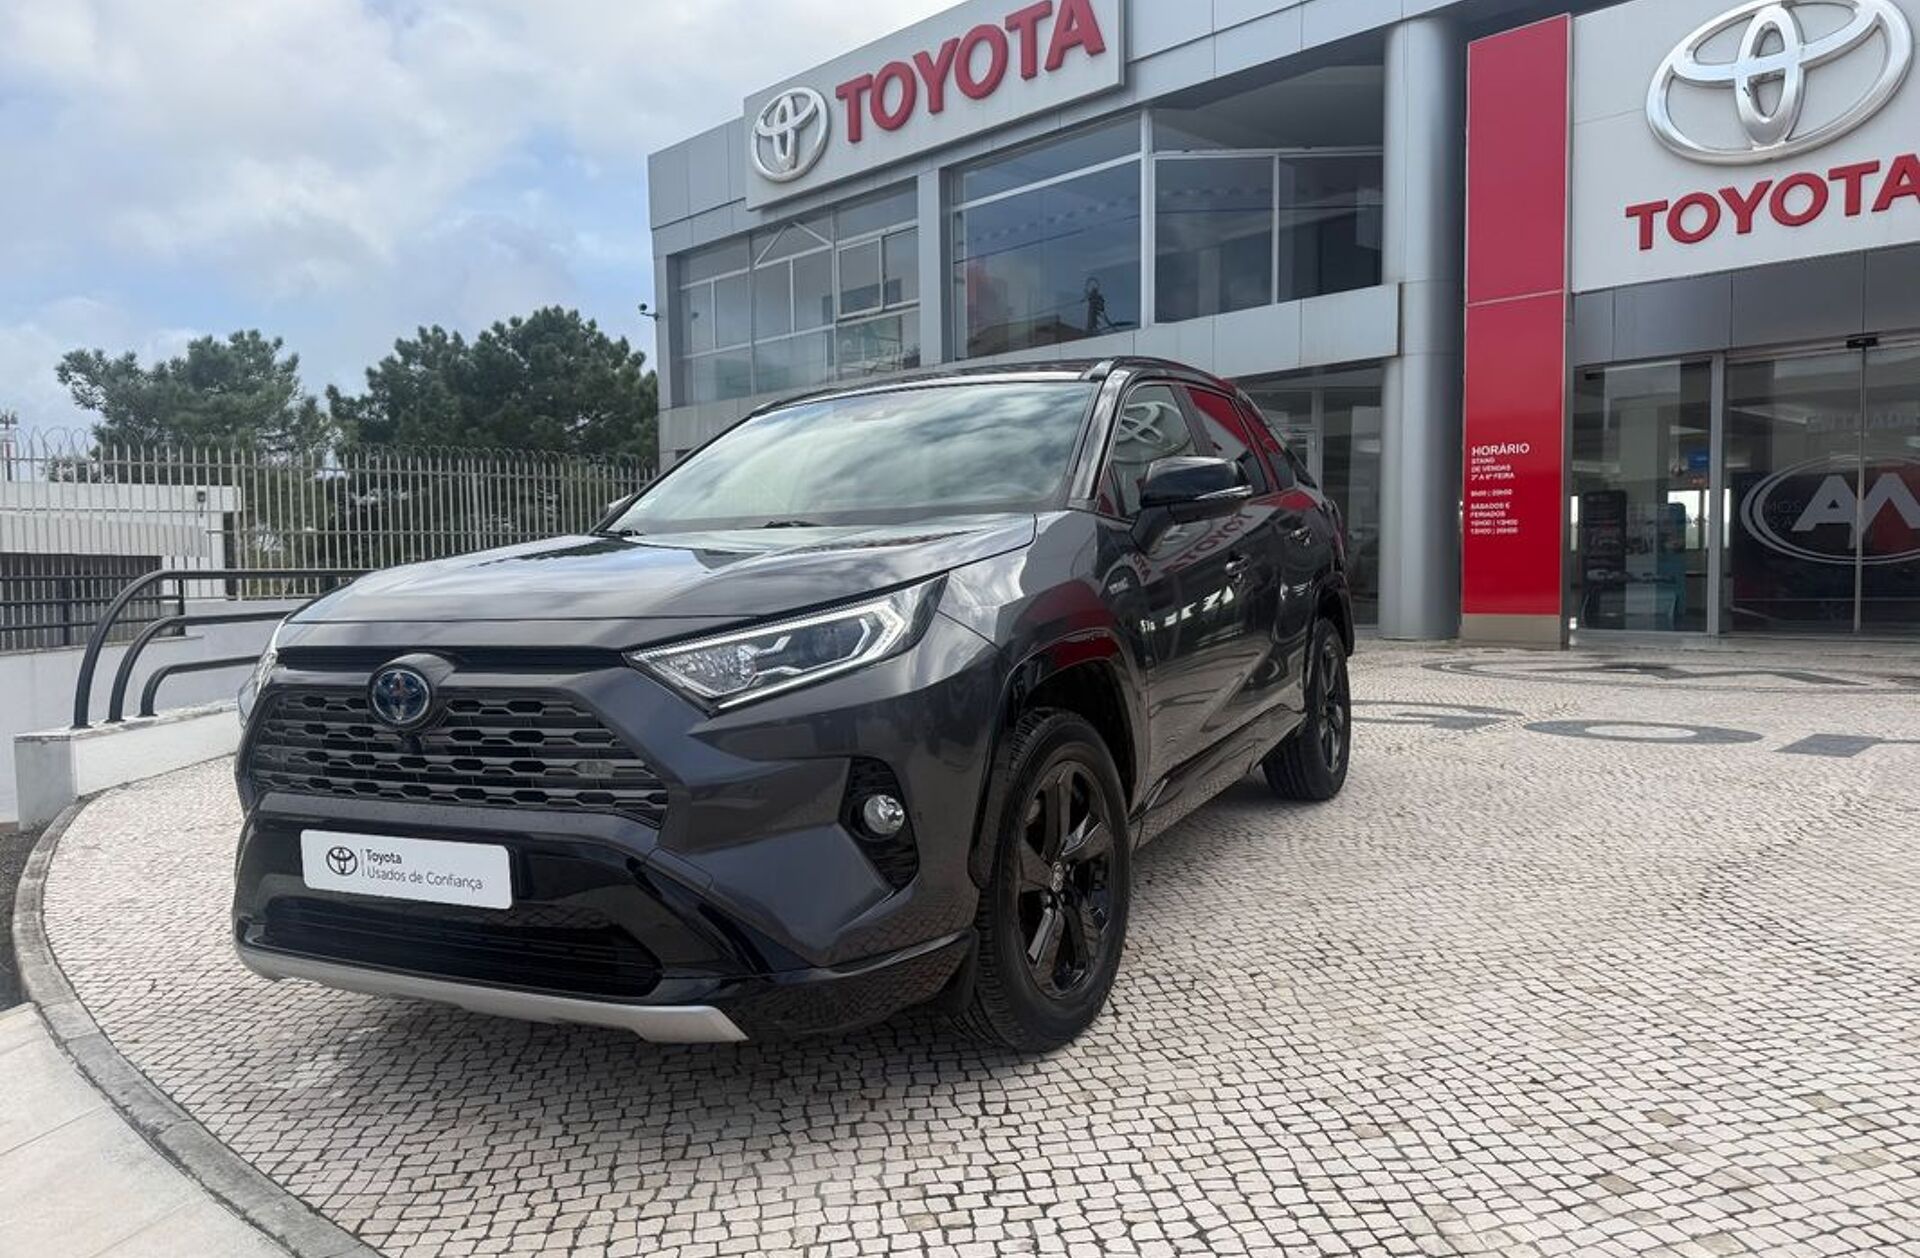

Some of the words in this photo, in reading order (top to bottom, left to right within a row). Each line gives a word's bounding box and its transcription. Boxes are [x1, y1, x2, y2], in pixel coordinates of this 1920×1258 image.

[836, 0, 1106, 143] TOYOTA
[1626, 153, 1920, 250] TOYOTA
[1472, 442, 1530, 456] HORÁRIO
[365, 849, 402, 865] Toyota
[366, 866, 406, 882] Usados
[408, 869, 424, 884] de
[426, 872, 483, 891] Confiança
